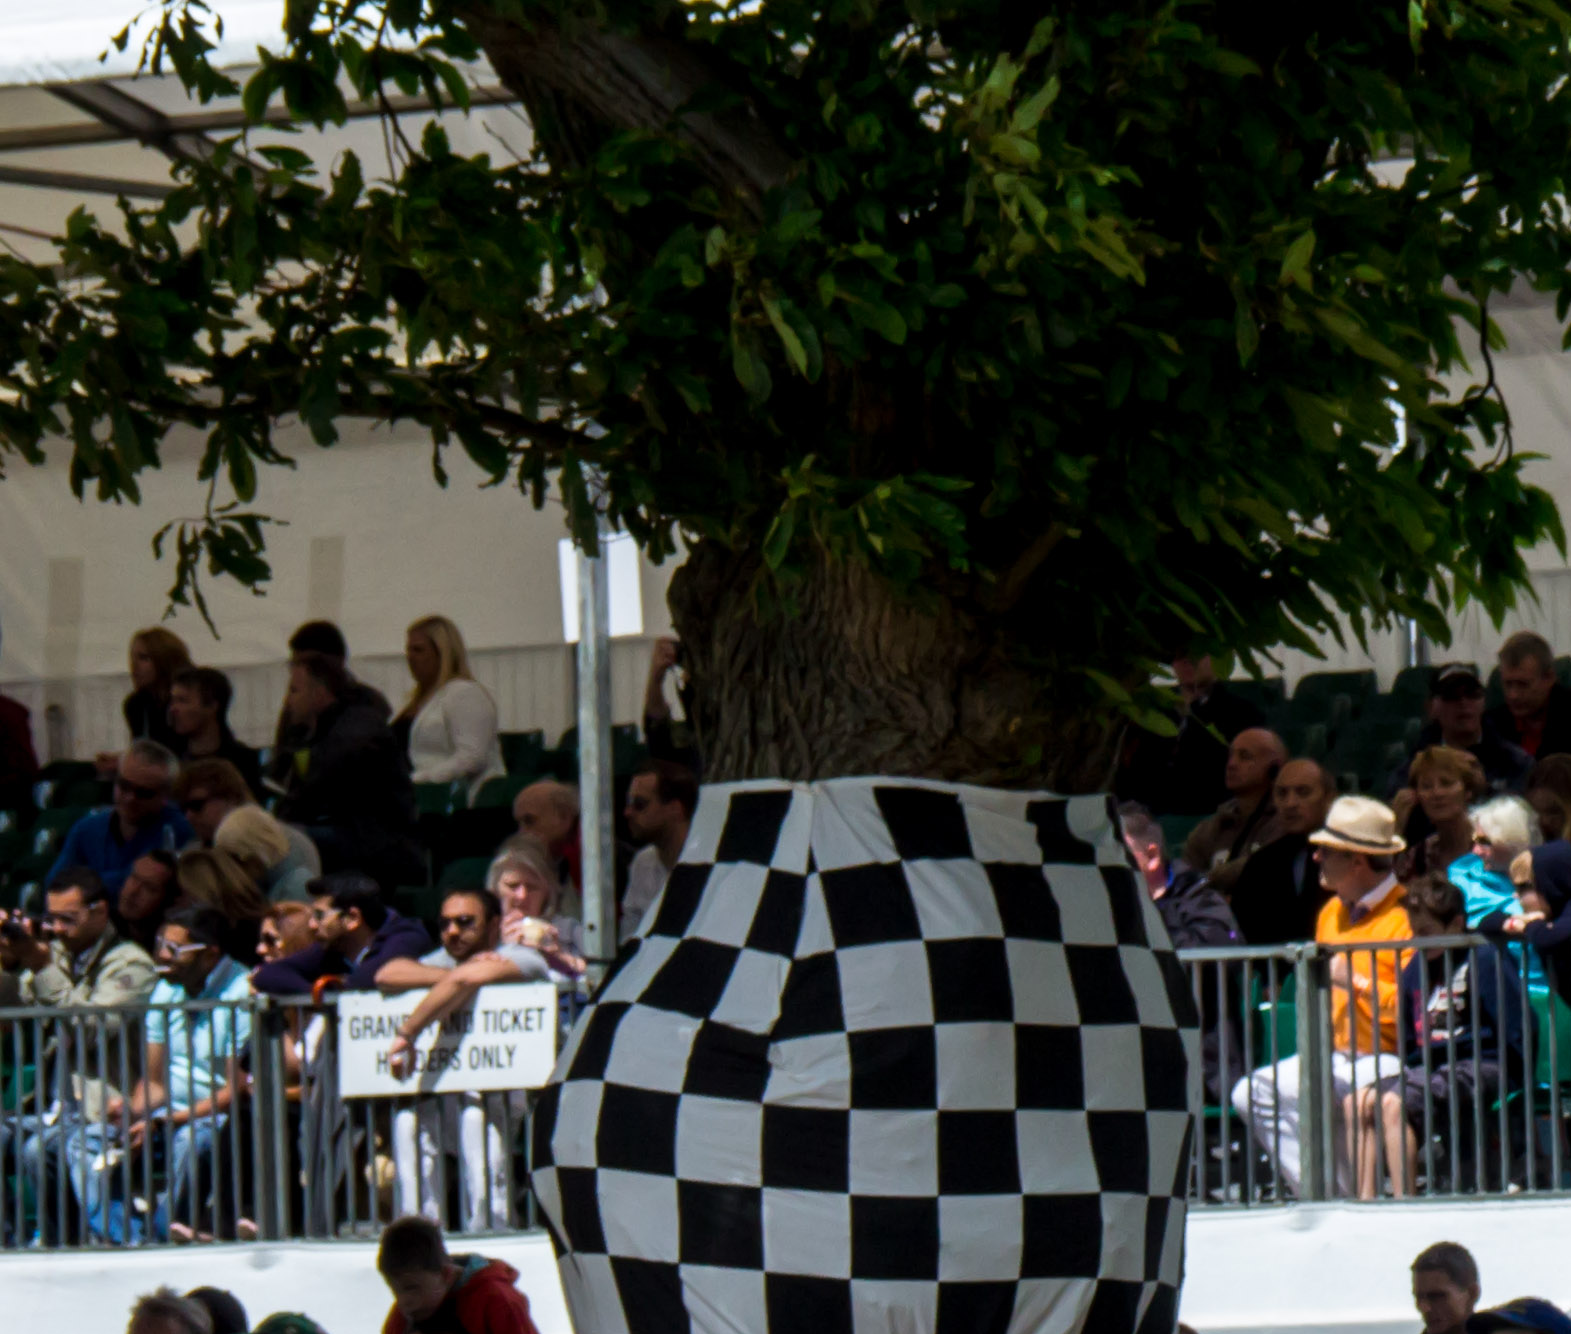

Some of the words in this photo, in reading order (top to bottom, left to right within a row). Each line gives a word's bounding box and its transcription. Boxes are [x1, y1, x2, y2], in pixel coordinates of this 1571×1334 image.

[350, 1009, 474, 1040] GRANAND
[482, 1007, 545, 1034] TICKET
[376, 1048, 461, 1074] HDERS
[469, 1045, 516, 1070] ONLY
